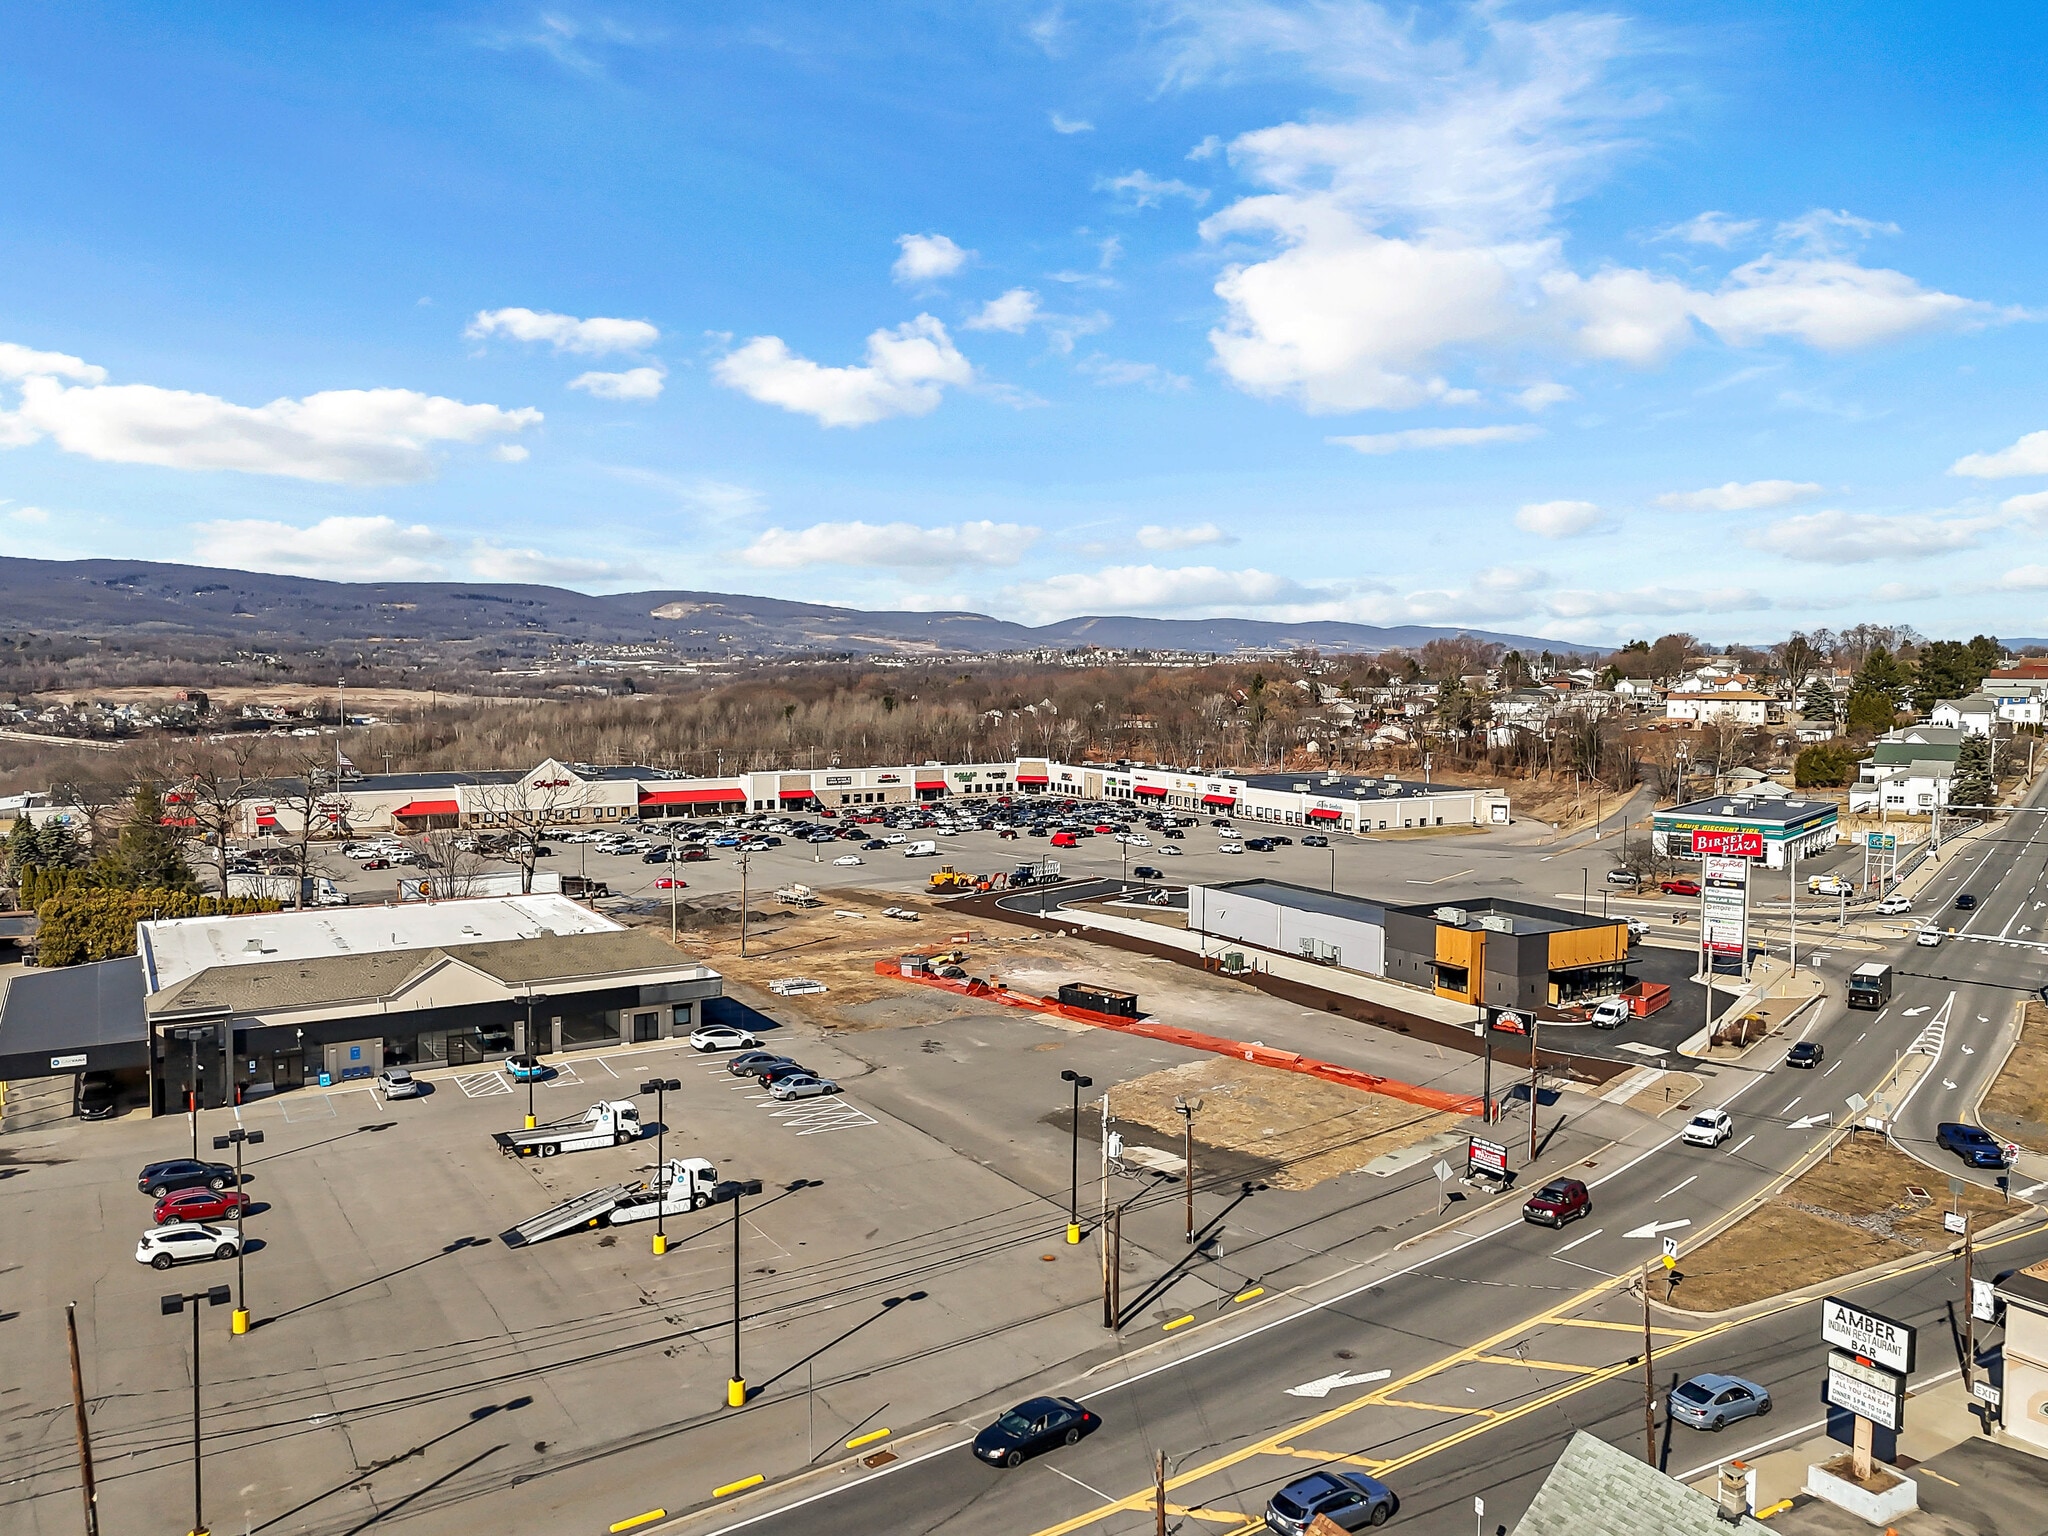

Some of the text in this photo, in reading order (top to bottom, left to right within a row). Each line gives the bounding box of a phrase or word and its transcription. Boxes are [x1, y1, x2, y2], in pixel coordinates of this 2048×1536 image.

[1697, 834, 1744, 850] BIRNEY
[1722, 840, 1757, 853] PLAZA
[1709, 859, 1743, 869] ShopRite
[1835, 1308, 1895, 1343] AMBER
[1828, 1319, 1902, 1356] INDIAN RESTAURANT
[1851, 1340, 1876, 1358] BAR
[1832, 1388, 1850, 1400] DINNER
[1835, 1381, 1889, 1408] ALL YOU CAN EAT
[1976, 1385, 1998, 1401] EXIT
[1832, 1395, 1892, 1427] BANQUET FACILITIES AVAILABLE
